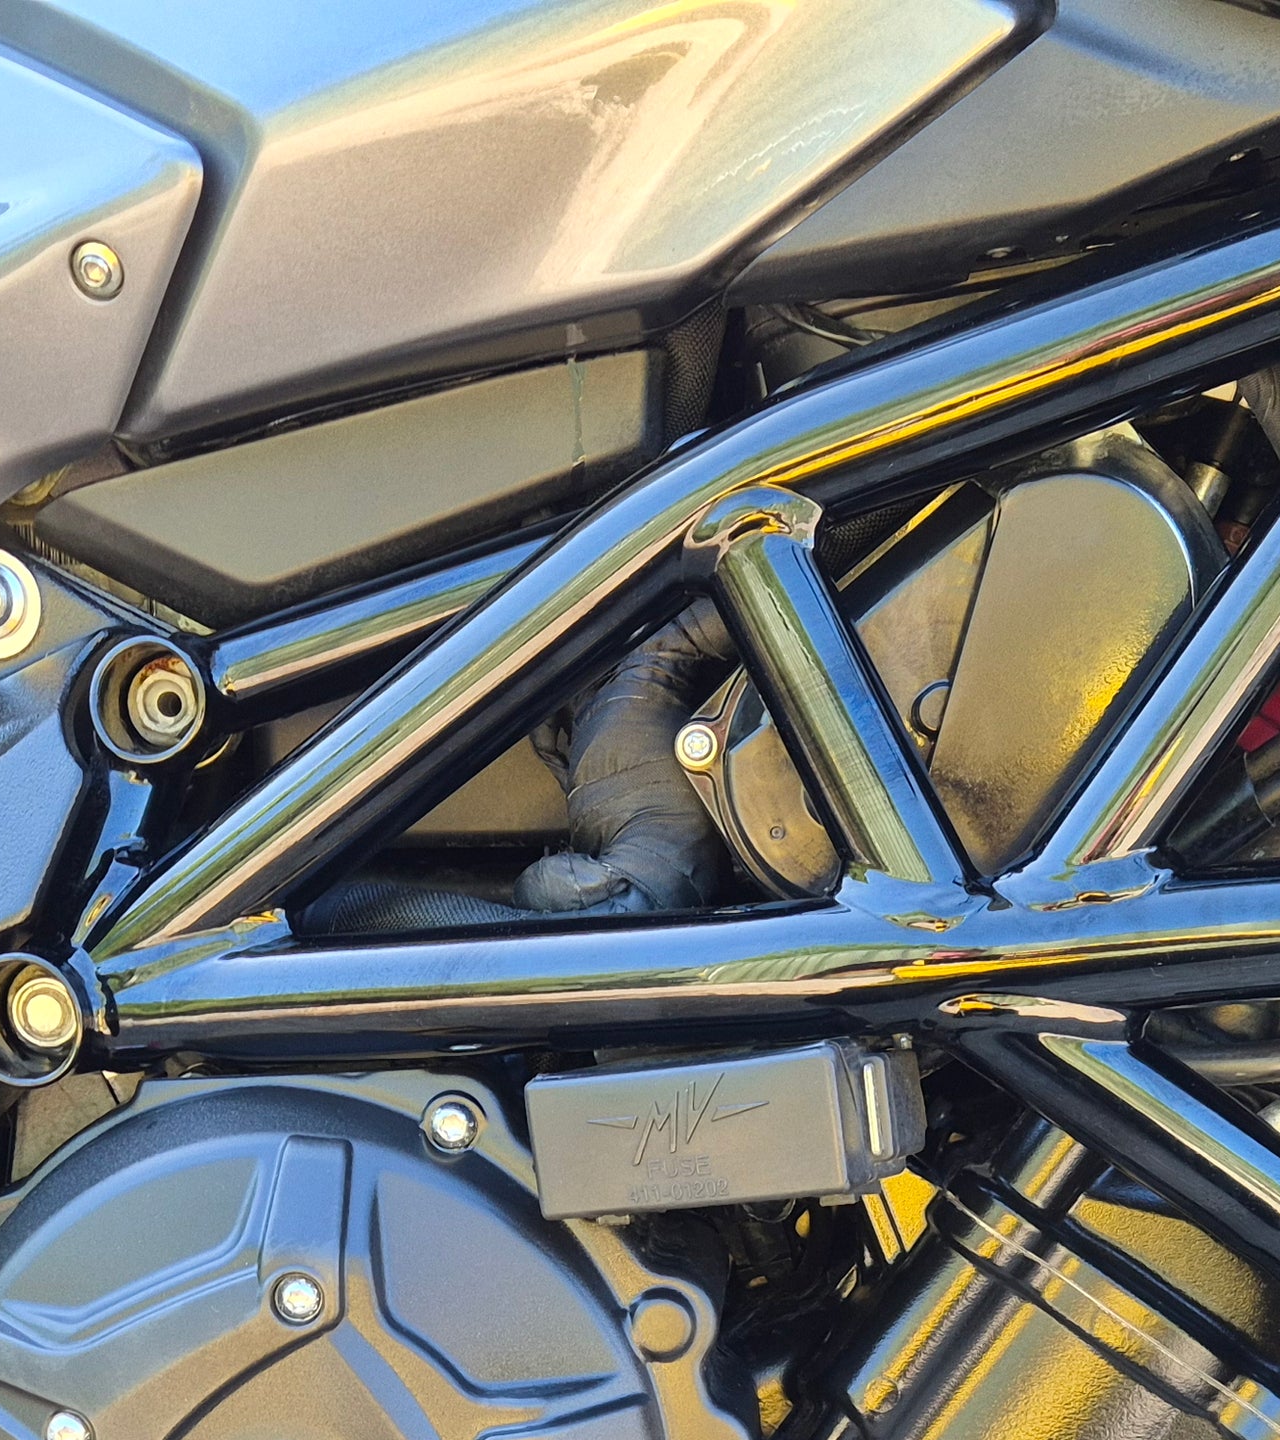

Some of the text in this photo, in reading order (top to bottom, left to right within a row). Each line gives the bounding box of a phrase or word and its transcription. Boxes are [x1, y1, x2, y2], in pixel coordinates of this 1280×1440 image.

[633, 1071, 725, 1167] MV
[647, 1155, 711, 1179] FUSE
[630, 1178, 729, 1203] 411-01202
